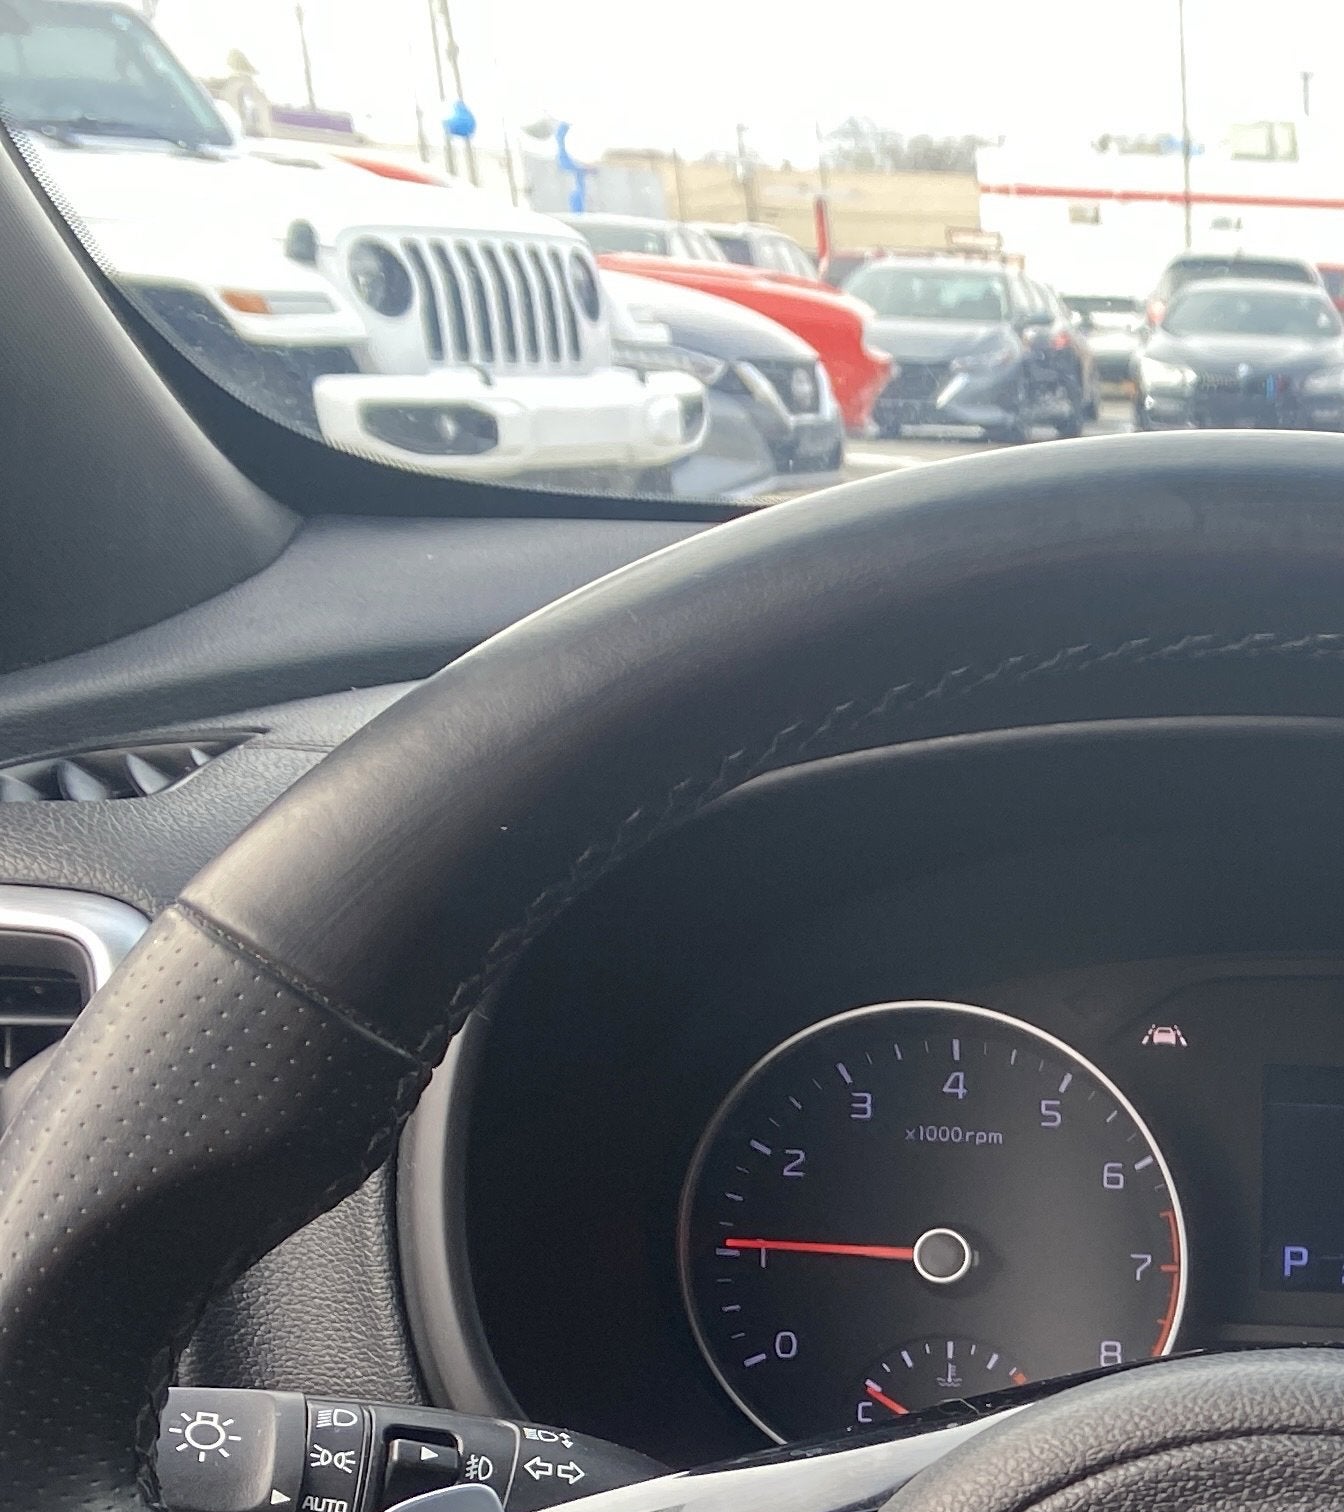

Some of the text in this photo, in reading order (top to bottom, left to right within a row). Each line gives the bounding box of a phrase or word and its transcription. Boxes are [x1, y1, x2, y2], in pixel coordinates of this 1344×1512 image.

[943, 1071, 967, 1098] 4
[850, 1092, 872, 1119] 3
[1040, 1100, 1062, 1128] 5
[782, 1149, 806, 1177] 2
[1103, 1162, 1124, 1190] 6
[1130, 1253, 1151, 1281] 7
[1284, 1246, 1309, 1277] P
[774, 1331, 797, 1359] 0
[1100, 1341, 1121, 1367] 8
[857, 1401, 873, 1423] C
